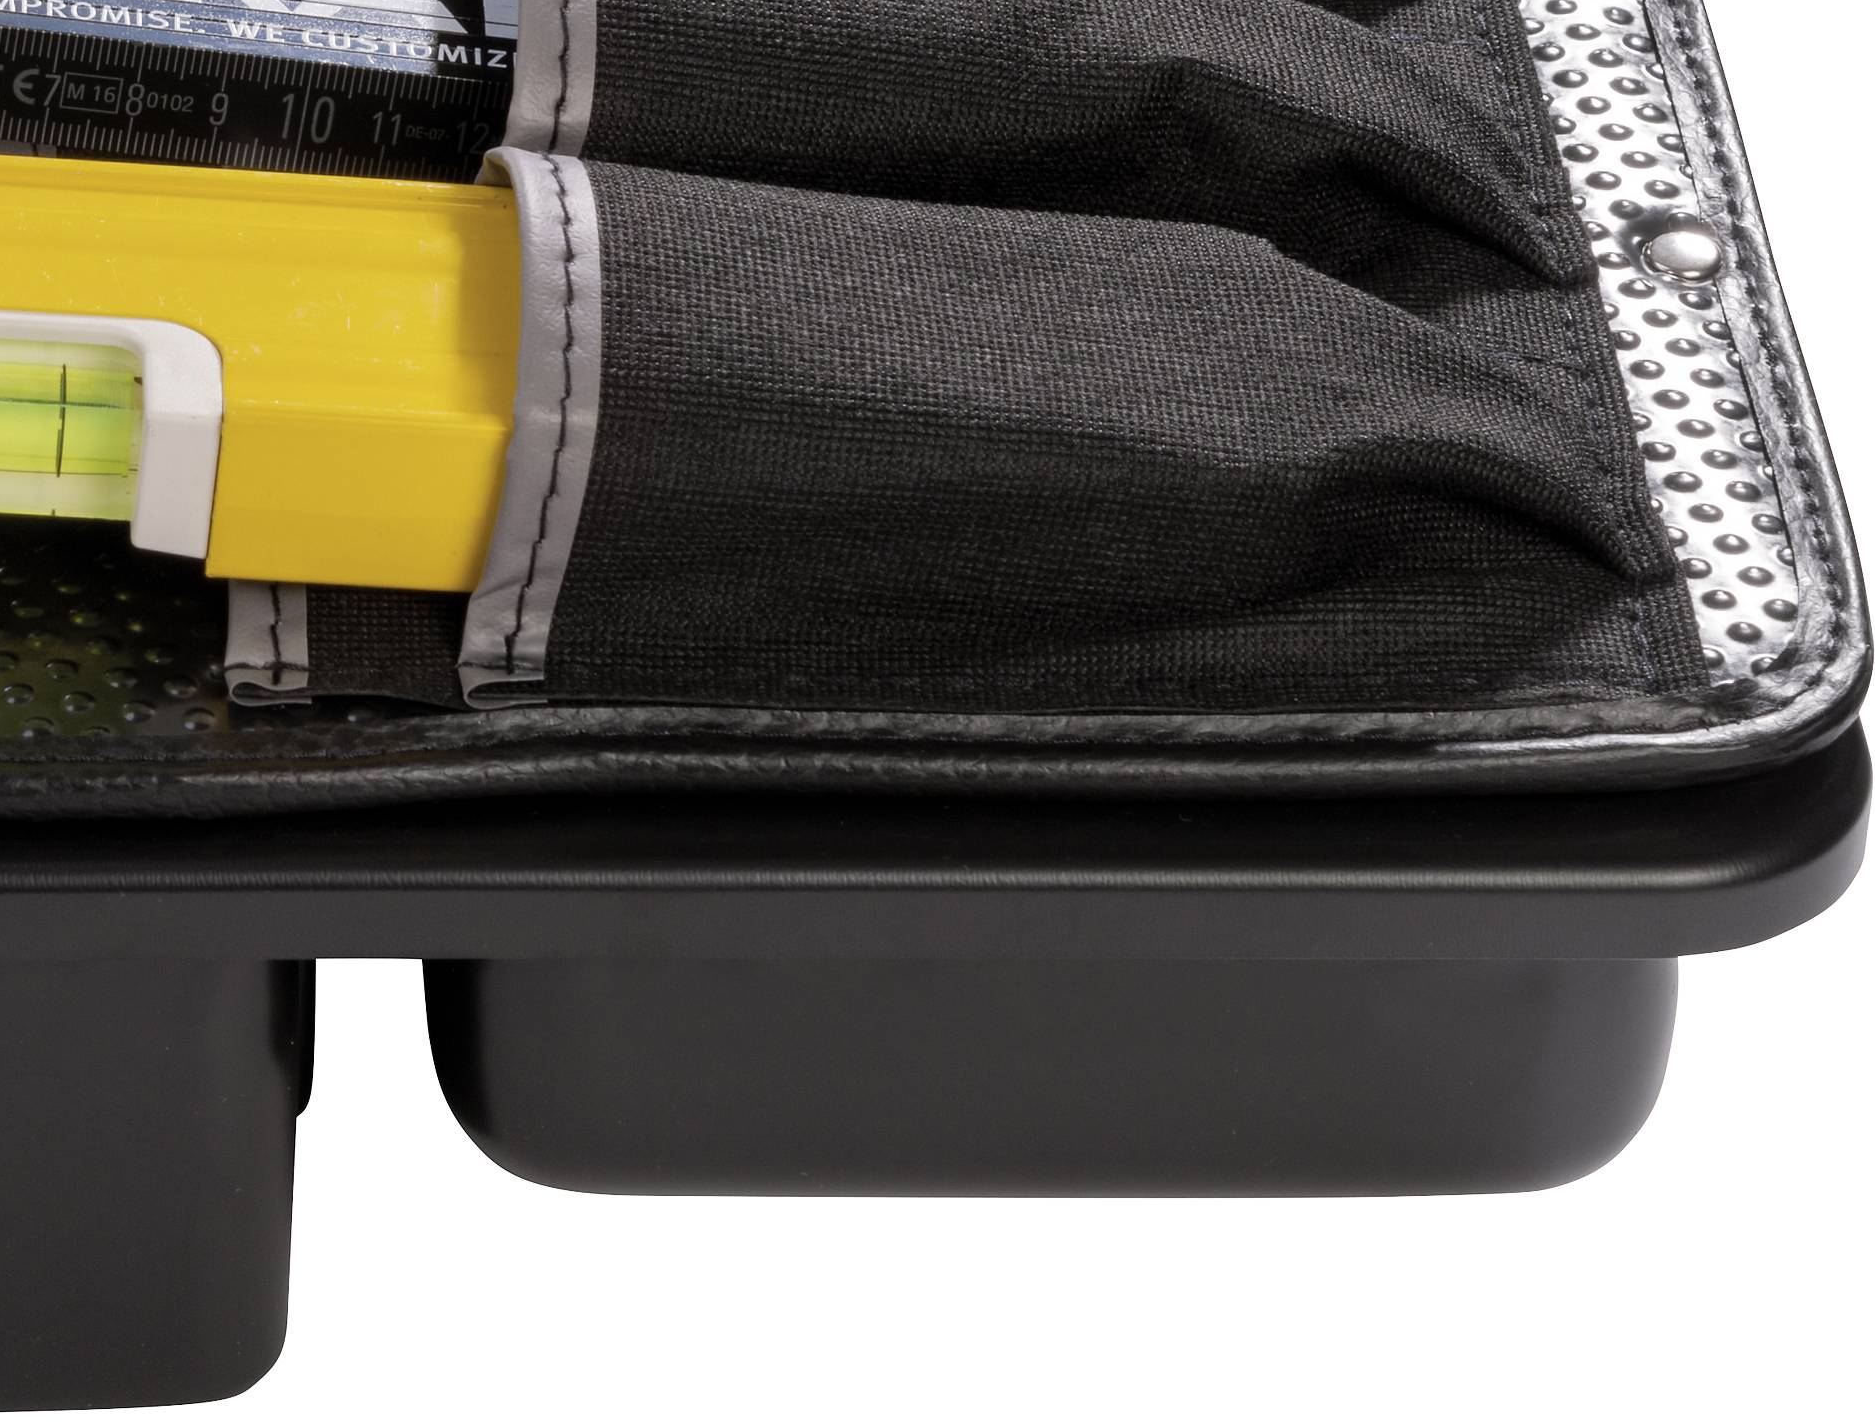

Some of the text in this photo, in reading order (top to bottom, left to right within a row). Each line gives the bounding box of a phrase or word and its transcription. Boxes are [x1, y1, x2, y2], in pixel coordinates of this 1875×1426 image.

[227, 19, 286, 43] WE
[42, 73, 62, 107] 7
[125, 82, 146, 117] 8
[146, 91, 195, 113] 0102
[209, 91, 230, 126] 9
[280, 92, 336, 145] 10
[371, 110, 403, 147] 11
[455, 120, 490, 155] 12
